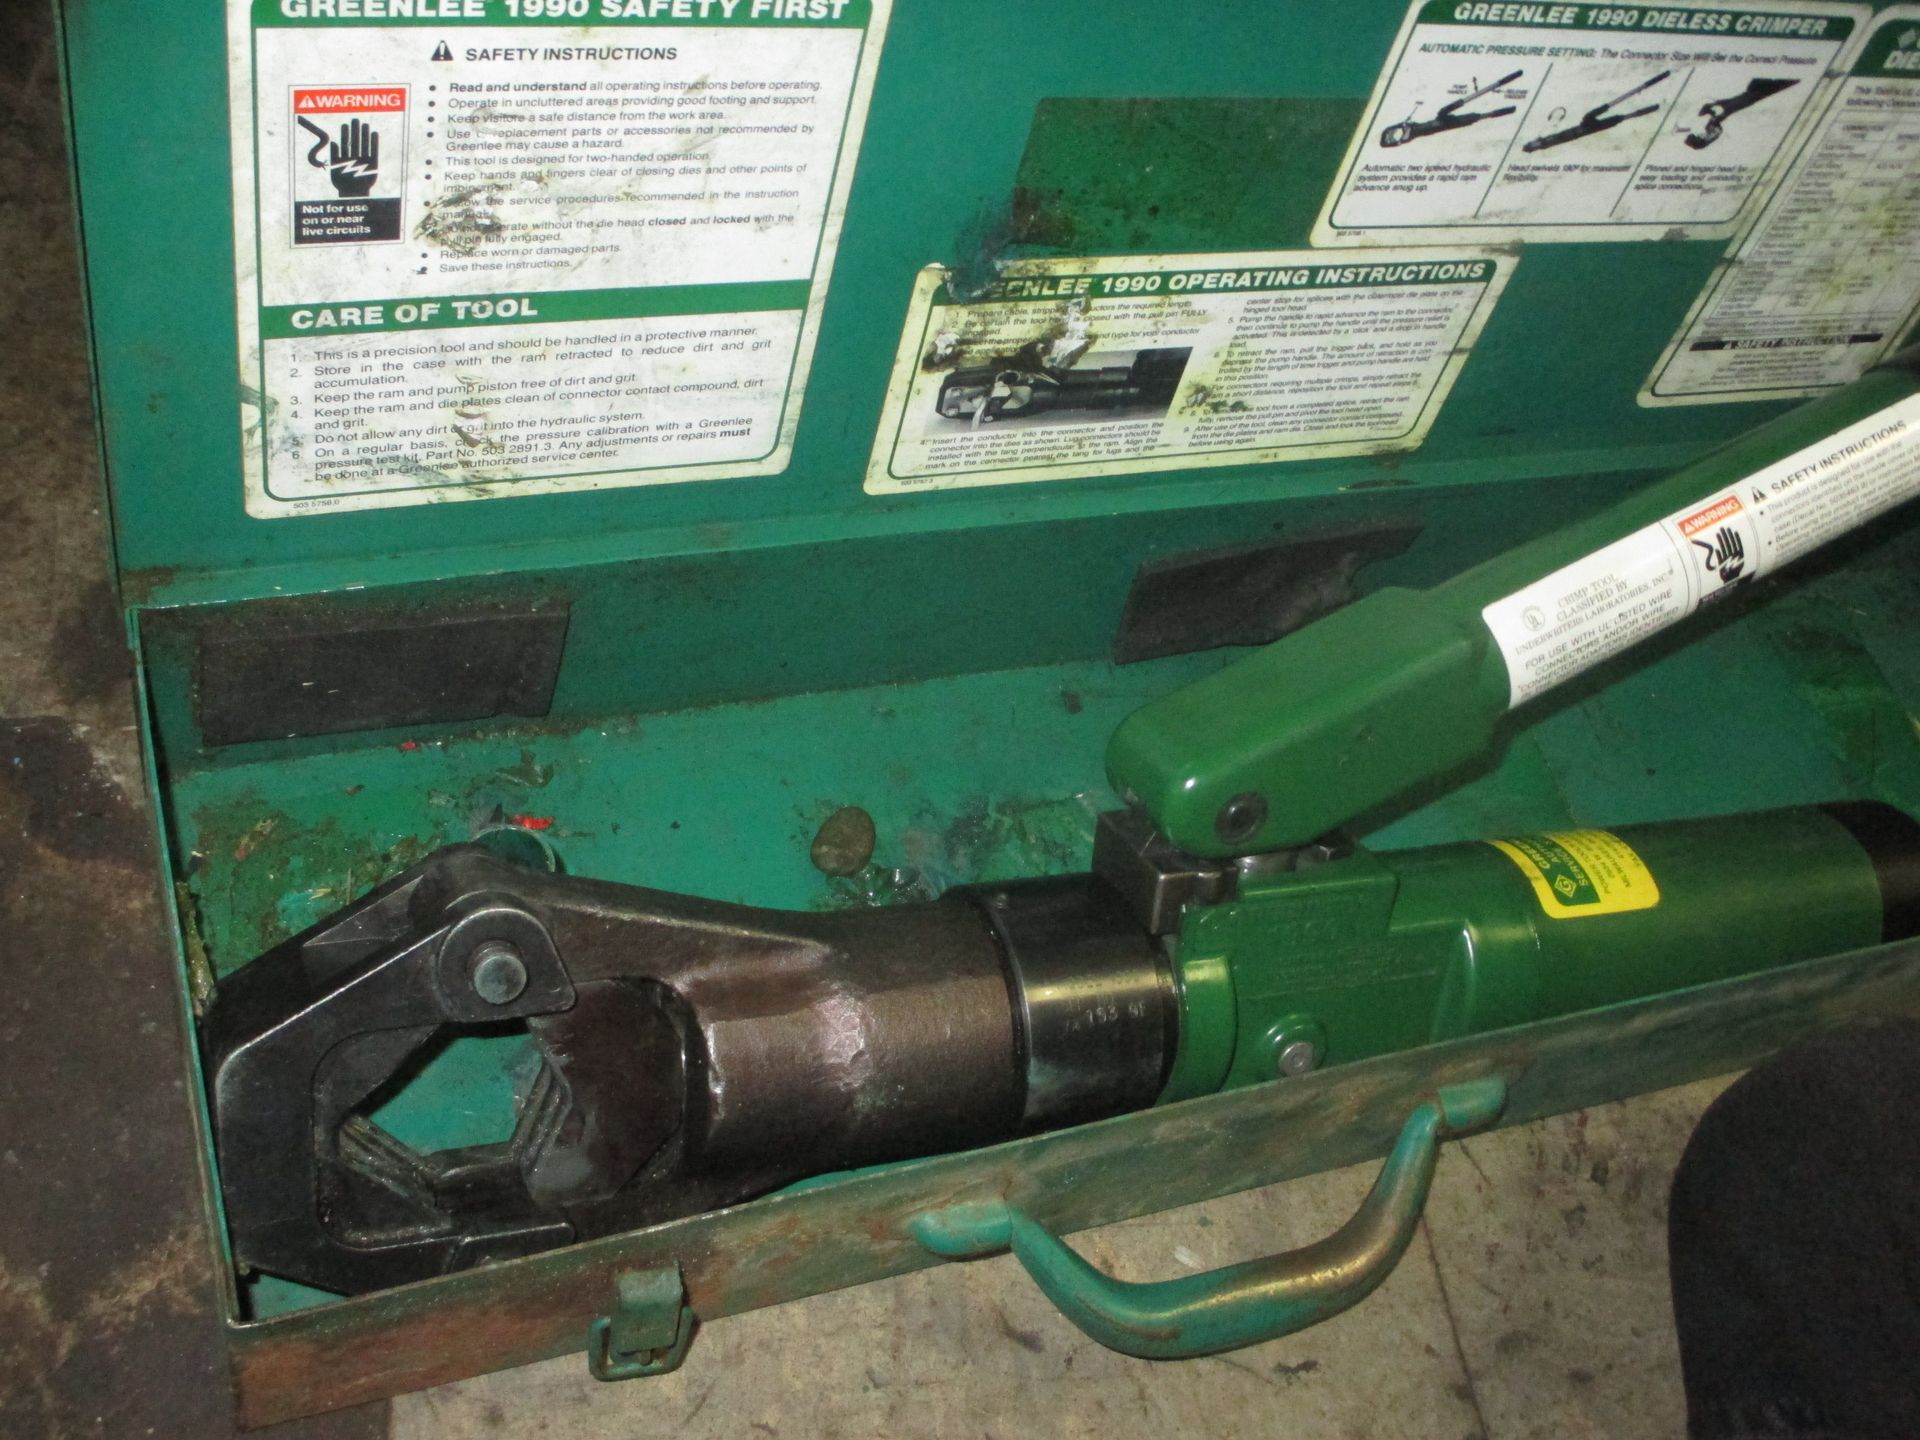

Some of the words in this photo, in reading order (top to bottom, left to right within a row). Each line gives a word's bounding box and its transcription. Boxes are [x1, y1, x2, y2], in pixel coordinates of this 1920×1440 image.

[281, 0, 485, 18] GREENLEE
[505, 0, 588, 18] 1990
[600, 0, 743, 19] SAFETY
[750, 0, 848, 19] FIRST
[1454, 3, 1578, 24] GREENLEE
[1587, 9, 1638, 26] 1990
[1642, 11, 1731, 32] DIELESS
[1735, 15, 1828, 36] CRIMPER
[466, 48, 536, 61] SAFETY
[543, 48, 677, 60] INSTRUCTIONS
[1419, 43, 1484, 55] AUTOMATIC
[1485, 45, 1546, 56] PRESSURE
[1601, 49, 1618, 59] The
[1620, 50, 1668, 61] Connector
[1883, 51, 1920, 70] DIE
[450, 82, 480, 94] Read
[485, 82, 508, 93] and
[513, 81, 587, 93] understand
[590, 81, 603, 91] all
[605, 80, 660, 93] operating
[663, 80, 728, 91] instructions
[731, 80, 766, 90] before
[769, 80, 822, 92] operating.
[316, 93, 401, 108] WARNING
[448, 98, 498, 110] Operate
[501, 97, 511, 107] in
[515, 96, 583, 107] uncluttered
[586, 98, 618, 106] areas
[622, 96, 674, 107] providing
[677, 96, 706, 107] good
[709, 95, 746, 106] footing
[750, 95, 770, 104] and
[773, 95, 816, 106] support.
[446, 141, 502, 151] Greenlee
[505, 142, 530, 152] may
[534, 141, 568, 149] cause
[582, 138, 624, 148] hazard.
[446, 156, 470, 166] This
[473, 155, 495, 165] tool
[499, 155, 507, 164] is
[511, 153, 565, 166] designed
[568, 153, 583, 163] for
[587, 151, 654, 162] two-handed
[657, 151, 710, 163] operation.
[303, 205, 324, 214] Not
[327, 204, 343, 213] for
[347, 204, 368, 213] use
[303, 217, 318, 225] on
[321, 216, 334, 224] or
[337, 214, 364, 224] near
[302, 226, 323, 236] live
[327, 225, 371, 235] circuits
[440, 249, 487, 260] Replace
[491, 249, 518, 257] worn
[522, 248, 532, 256] or
[536, 245, 589, 257] damaged
[591, 244, 620, 255] parts.
[440, 263, 468, 273] Save
[472, 261, 502, 271] these
[506, 259, 571, 270] instructions.
[1102, 275, 1161, 293] 1990
[1168, 270, 1310, 291] OPERATING
[1316, 263, 1486, 283] INSTRUCTIONS
[291, 306, 384, 329] CARE
[394, 303, 440, 323] OF
[452, 298, 538, 320] TOOL
[315, 351, 343, 361] This
[349, 350, 359, 359] is
[374, 346, 437, 359] precision
[441, 343, 465, 353] tool
[469, 341, 494, 351] and
[497, 339, 541, 350] should
[545, 337, 561, 347] be
[565, 334, 617, 345] handled
[620, 333, 631, 342] in
[646, 329, 706, 342] protective
[710, 328, 758, 337] manner.
[314, 365, 350, 376] Store
[361, 364, 372, 372] in
[383, 361, 403, 371] the
[413, 360, 446, 369] case
[455, 356, 482, 366] with
[492, 354, 512, 364] the
[521, 353, 546, 362] ram
[556, 349, 612, 360] retracted
[621, 347, 633, 357] to
[641, 344, 685, 355] reduce
[693, 342, 713, 352] dirt
[722, 340, 744, 350] and
[751, 339, 771, 352] grit
[314, 374, 409, 388] accumulation.
[314, 459, 373, 471] pressure
[377, 455, 399, 465] test
[403, 452, 422, 464] kit,
[426, 450, 452, 461] Part
[456, 448, 476, 458] No.
[481, 445, 505, 456] 503
[560, 441, 583, 452] Any
[586, 436, 659, 449] adjustments
[662, 434, 673, 442] or
[677, 431, 717, 442] repairs
[720, 428, 750, 438] must
[1771, 465, 1817, 493] SAFETY
[1819, 420, 1907, 469] INSTRUCTIONS
[1690, 499, 1739, 529] WARNING
[1557, 587, 1613, 621] CLASSIFIED
[1616, 578, 1628, 593] BY
[1558, 587, 1589, 608] CRIMP
[1590, 573, 1617, 592] TOOL
[1515, 616, 1583, 655] UNDERWRITERS
[1525, 654, 1545, 670] FOR
[1548, 643, 1568, 660] USE
[1571, 629, 1596, 648] WITH
[1598, 620, 1612, 633] UL
[1614, 602, 1647, 627] LISTED
[1649, 588, 1673, 607] WIRE
